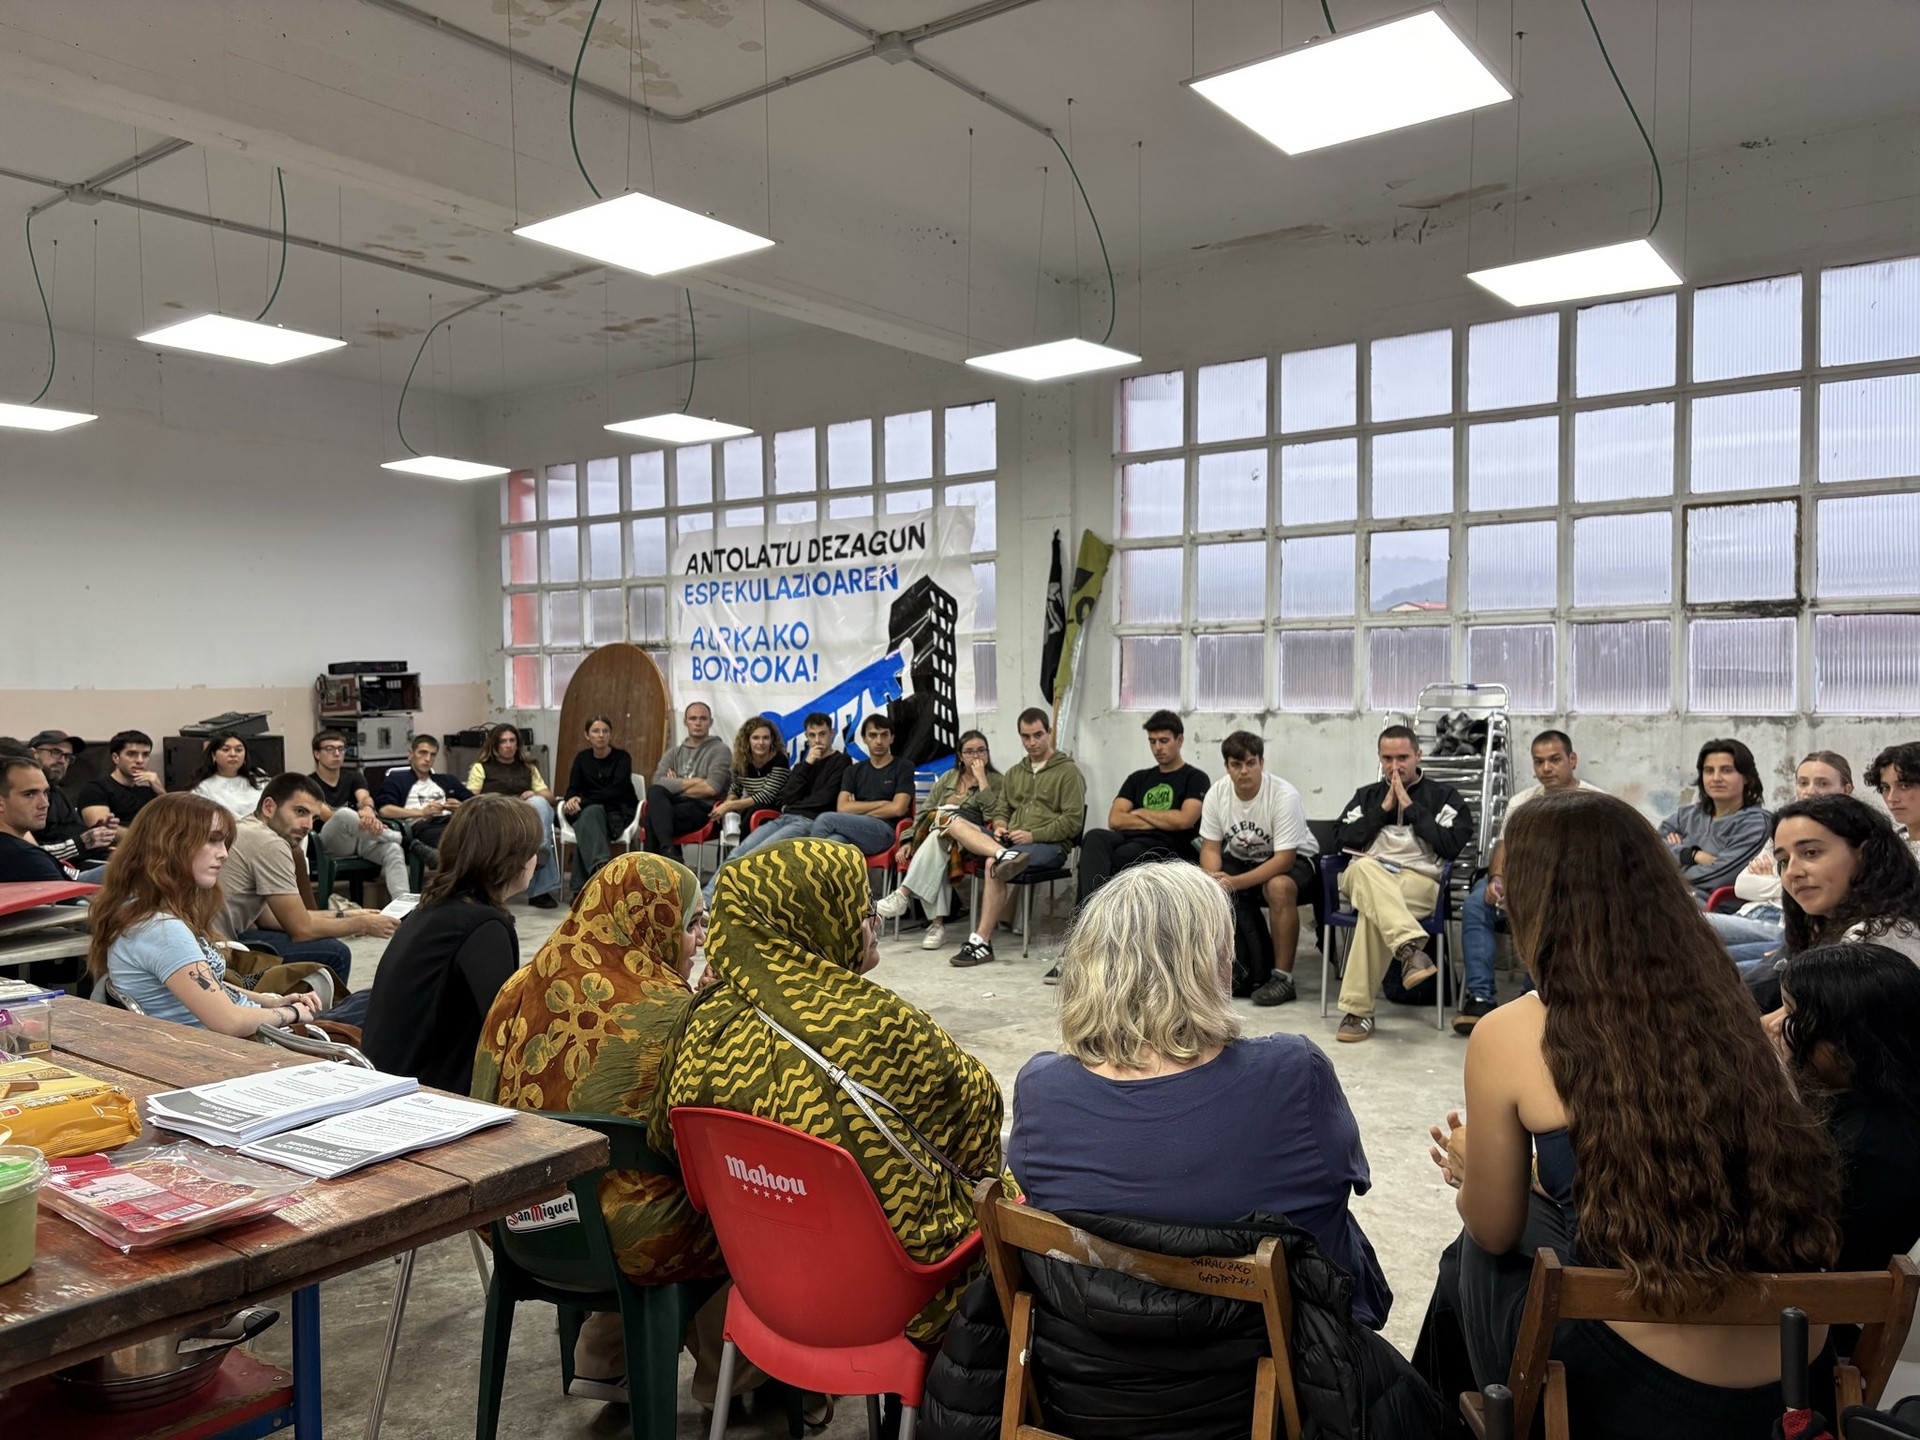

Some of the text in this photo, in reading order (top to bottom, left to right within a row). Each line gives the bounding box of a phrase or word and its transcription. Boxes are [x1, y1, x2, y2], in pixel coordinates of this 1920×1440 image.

[685, 522, 925, 575] ANTOLATU DEZAGUN
[684, 564, 899, 605] ESPEKULAZIOAREN
[690, 621, 809, 652] AURKAKO
[692, 653, 818, 683] BORROKA!
[724, 1154, 808, 1196] Mahou
